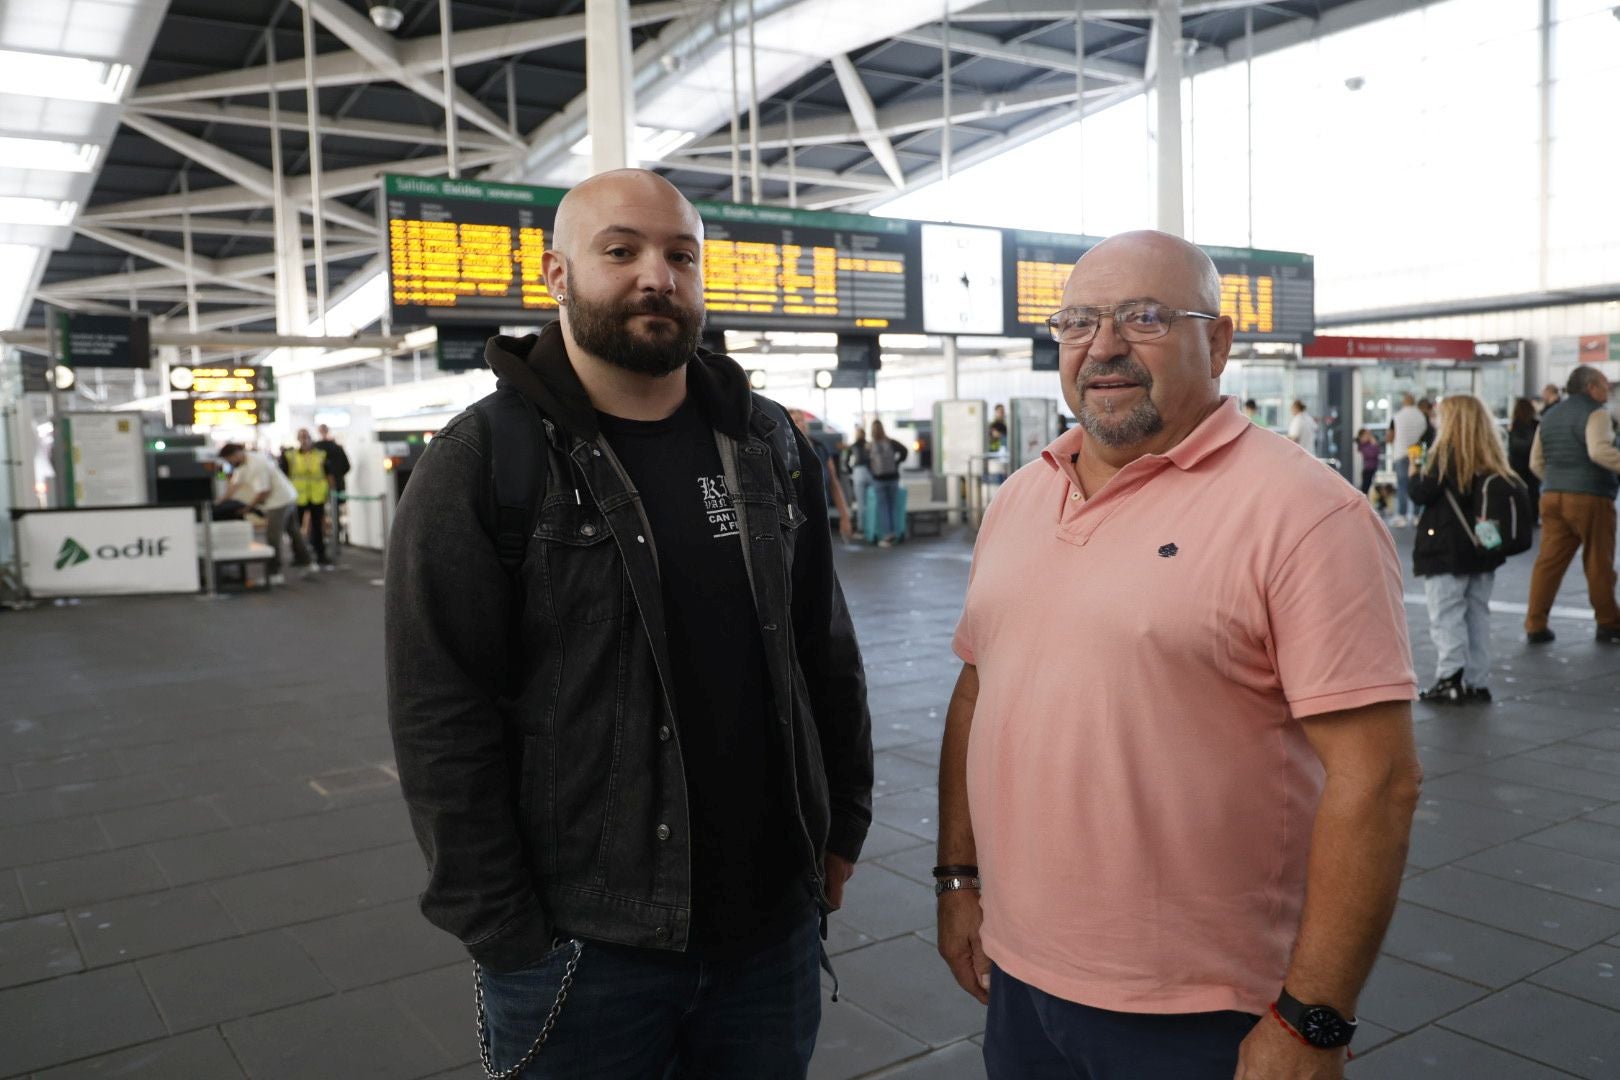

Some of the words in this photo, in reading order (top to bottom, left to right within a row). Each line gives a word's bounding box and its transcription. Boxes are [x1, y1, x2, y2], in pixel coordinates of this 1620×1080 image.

[708, 513, 730, 523] CAN
[720, 523, 728, 532] A
[97, 536, 171, 559] adif
